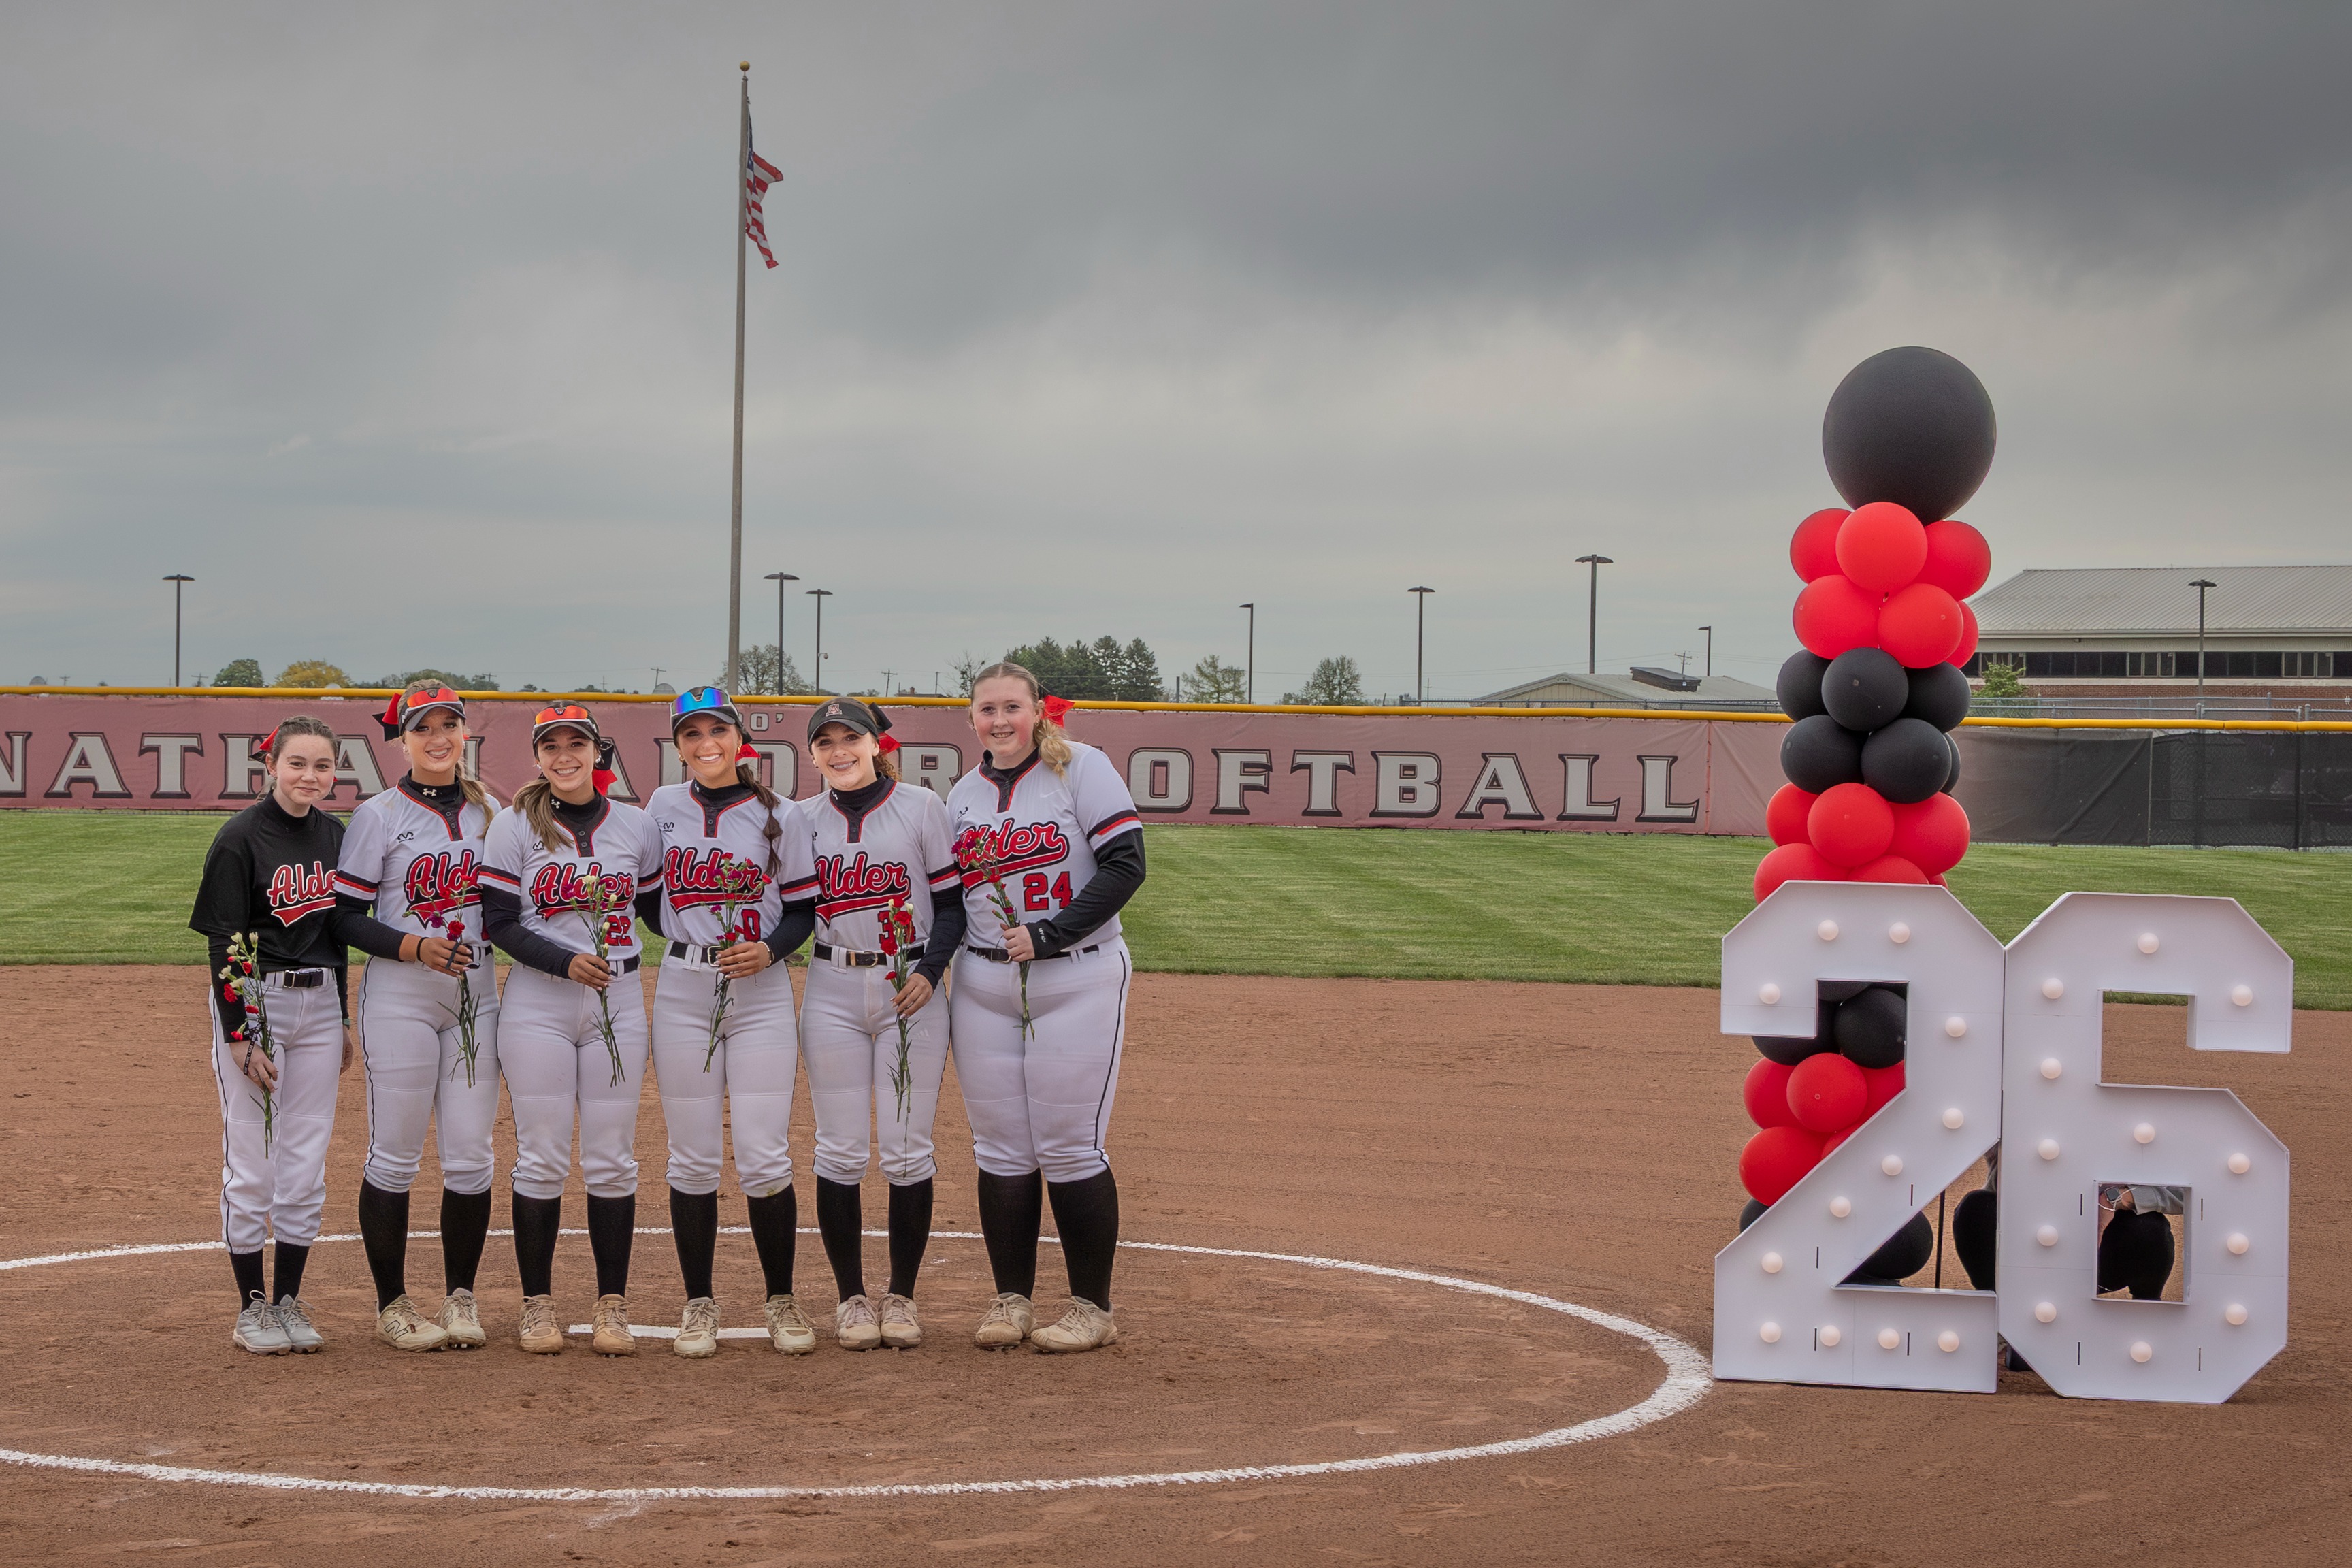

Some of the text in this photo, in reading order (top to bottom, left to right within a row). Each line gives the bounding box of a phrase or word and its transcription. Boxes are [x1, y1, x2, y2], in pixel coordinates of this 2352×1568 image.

[0, 731, 485, 801] ATHA
[1093, 746, 1699, 823] OFTBALL
[267, 860, 336, 906] Alde
[663, 846, 764, 893] Aldr
[1022, 870, 1073, 912] 24
[1714, 879, 2294, 1404] 26
